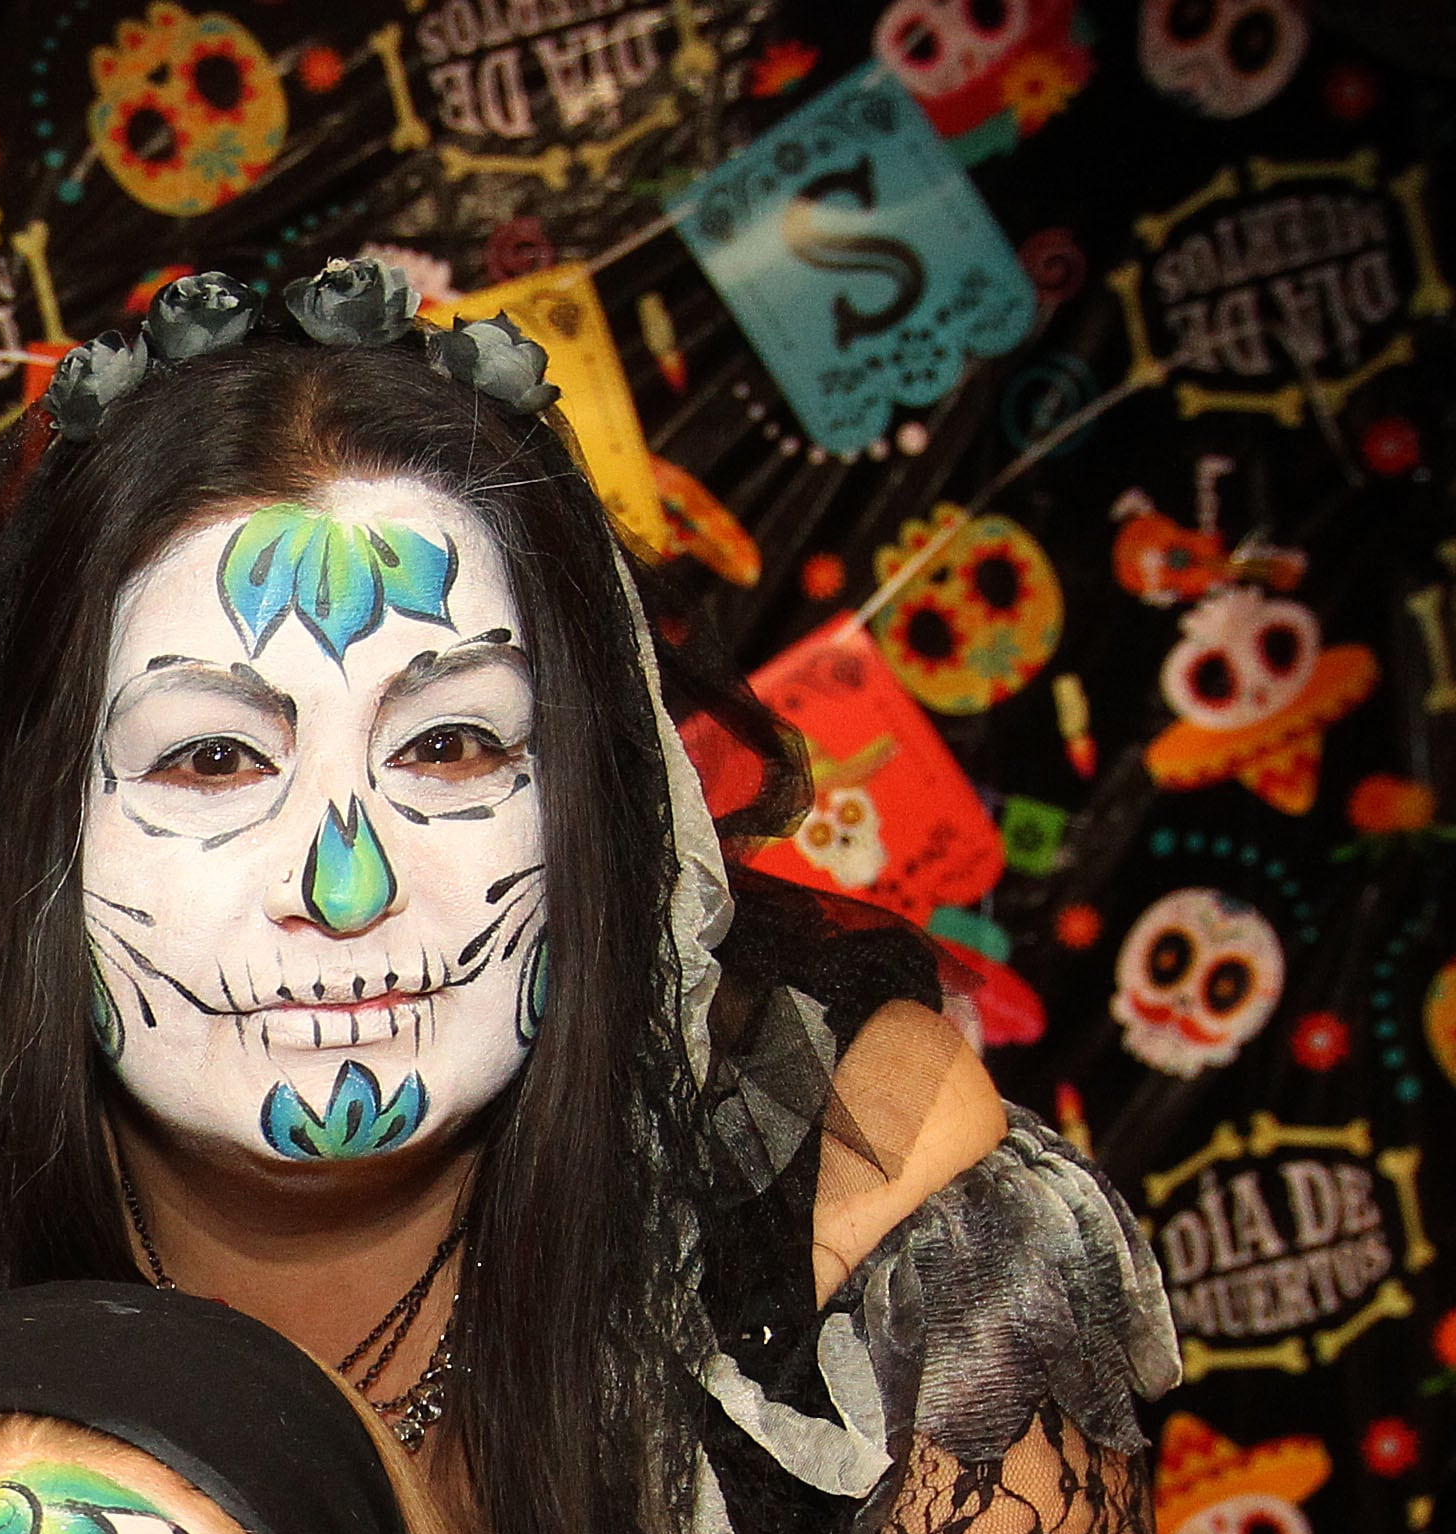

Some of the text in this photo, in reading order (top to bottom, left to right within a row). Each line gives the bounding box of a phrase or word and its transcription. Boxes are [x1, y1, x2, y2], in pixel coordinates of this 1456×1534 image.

[428, 45, 538, 139] DE
[782, 156, 925, 348] S
[1161, 1160, 1382, 1283] DÍA DE
[1174, 1234, 1392, 1336] MUERTOS
